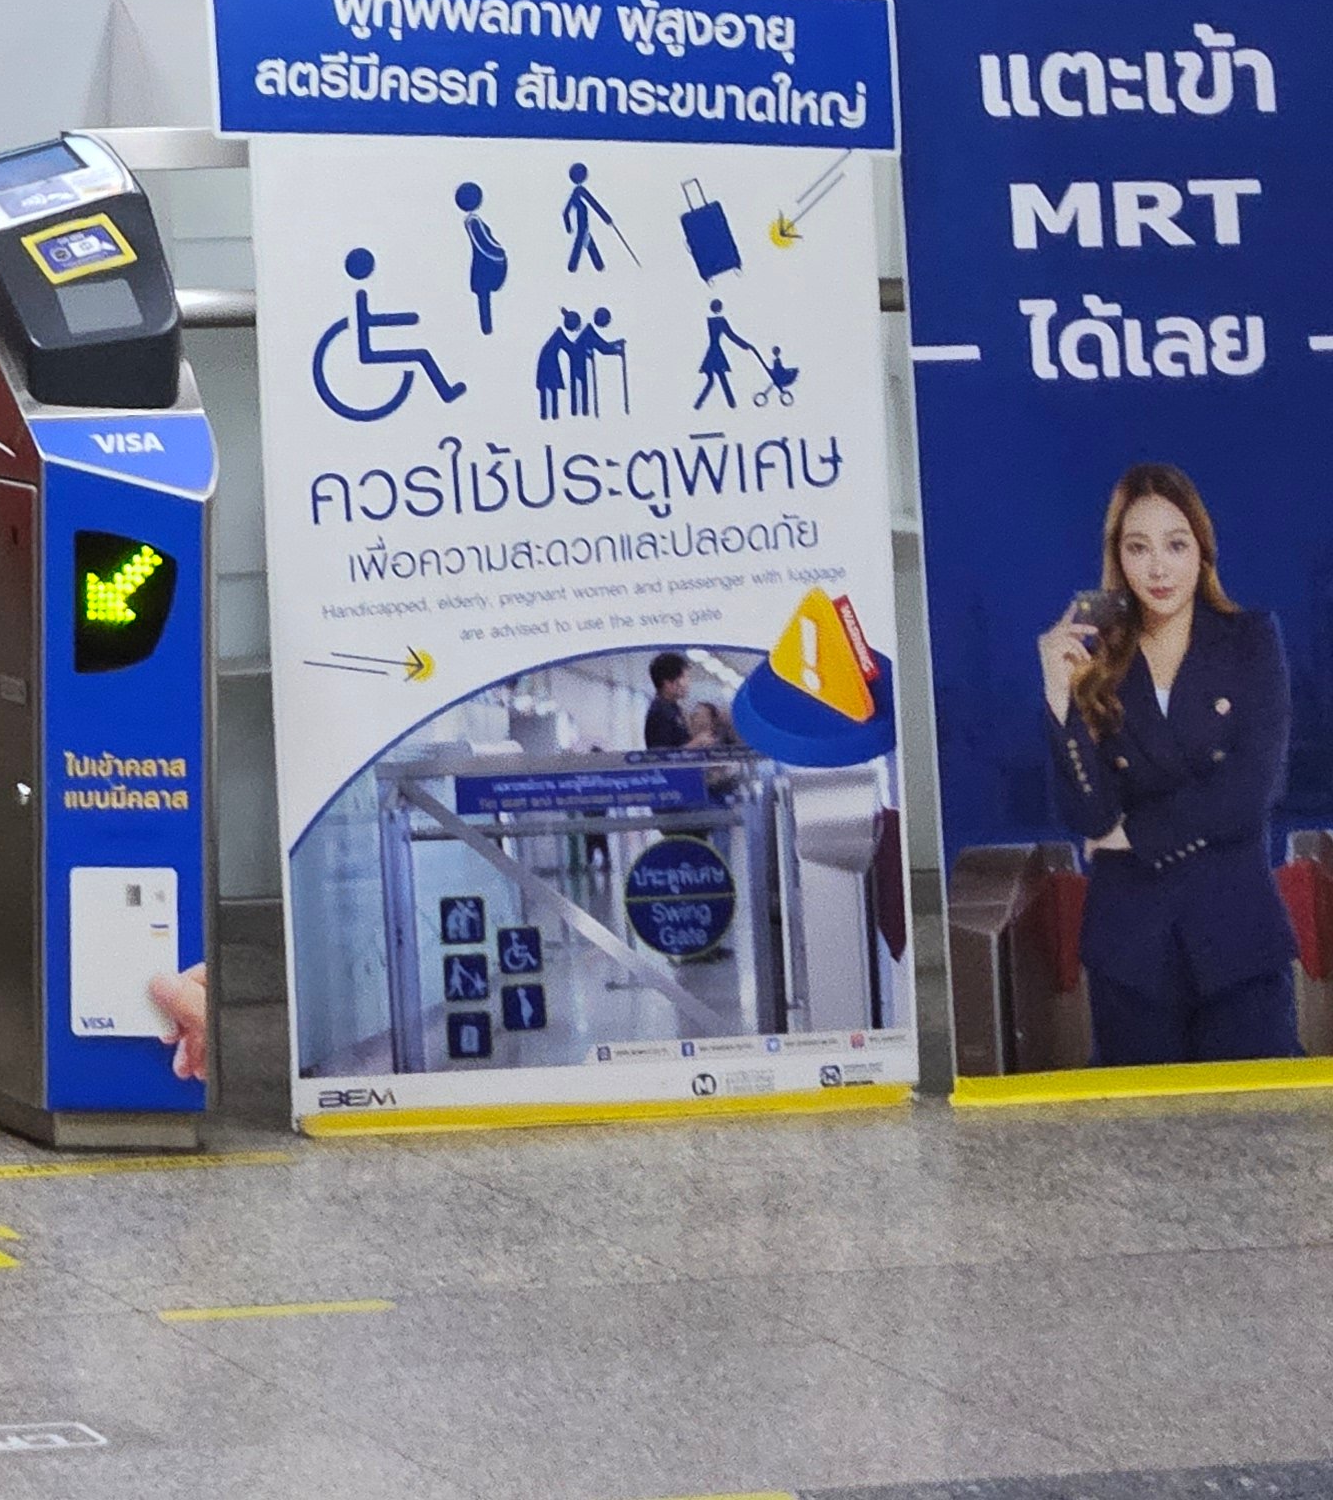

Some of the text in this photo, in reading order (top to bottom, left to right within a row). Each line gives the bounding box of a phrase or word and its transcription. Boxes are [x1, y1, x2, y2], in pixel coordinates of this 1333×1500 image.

[977, 22, 1278, 119] แตะเข้า
[254, 49, 870, 131] สตรีมีครรภ์ สัมภาระขนาดใหญ่
[1009, 177, 1264, 251] MRT
[1019, 293, 1267, 382] ได้เลย
[89, 431, 166, 456] VISA
[309, 432, 844, 526] ควรใช้ประตูพิเศษ
[347, 512, 820, 583] เพื่อความสะดวกและปลอดภัย
[499, 586, 566, 608] pregnant
[573, 584, 628, 600] women
[633, 579, 663, 596] and
[669, 573, 745, 597] passenger
[752, 568, 782, 585] with
[460, 606, 723, 642] are advised to use the swing gate
[63, 749, 187, 778] ไปเข้าคลาส
[64, 782, 189, 811] แบบมีคลาส
[651, 902, 713, 926] Swing
[658, 926, 708, 948] Gate
[79, 1015, 115, 1030] VISA
